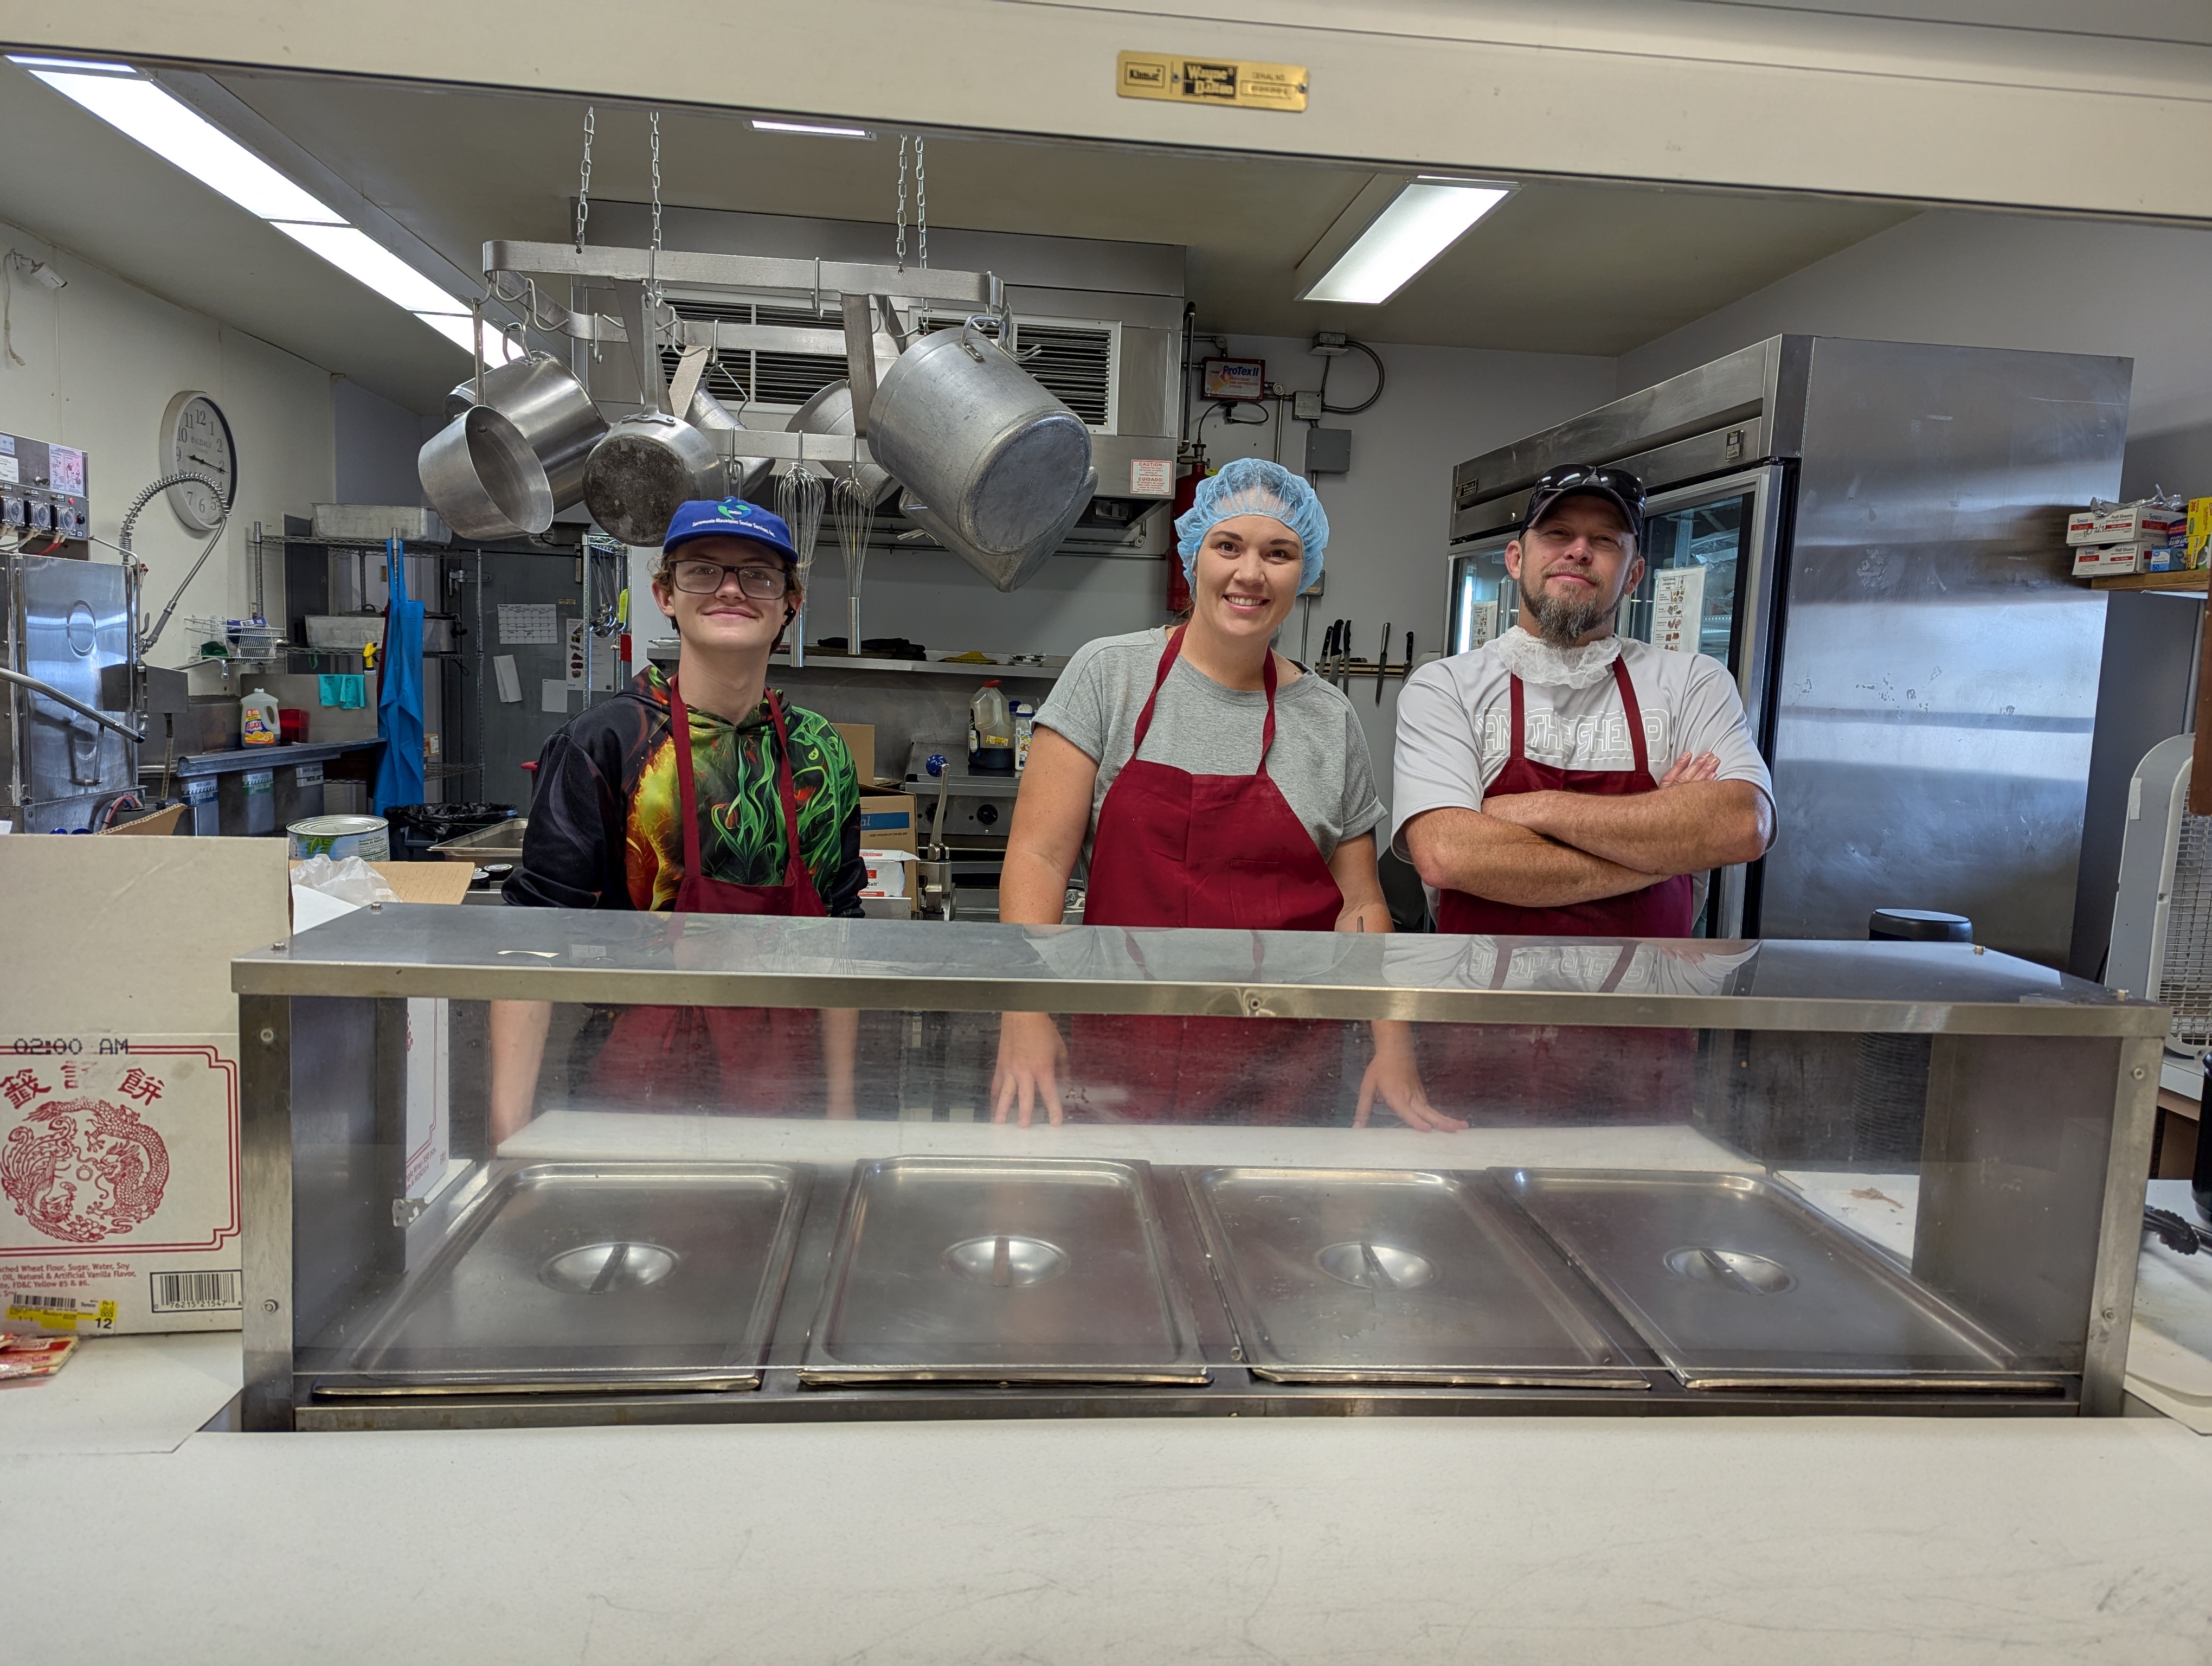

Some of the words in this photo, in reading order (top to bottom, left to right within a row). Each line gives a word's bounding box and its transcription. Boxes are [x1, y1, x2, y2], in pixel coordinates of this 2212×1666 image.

[1223, 365, 1252, 376] ProTex
[185, 413, 194, 429] 11
[196, 409, 206, 426] 12
[177, 426, 188, 443] 10
[210, 421, 215, 436] 1
[217, 438, 222, 453] 2
[176, 446, 182, 462] 9
[187, 491, 193, 505] 7
[199, 498, 205, 513] 6
[1527, 714, 1572, 756] THE
[1577, 716, 1663, 758] SHEP
[14, 1039, 82, 1055] 02:00
[99, 1039, 128, 1055] AM
[95, 1317, 112, 1329] 12
